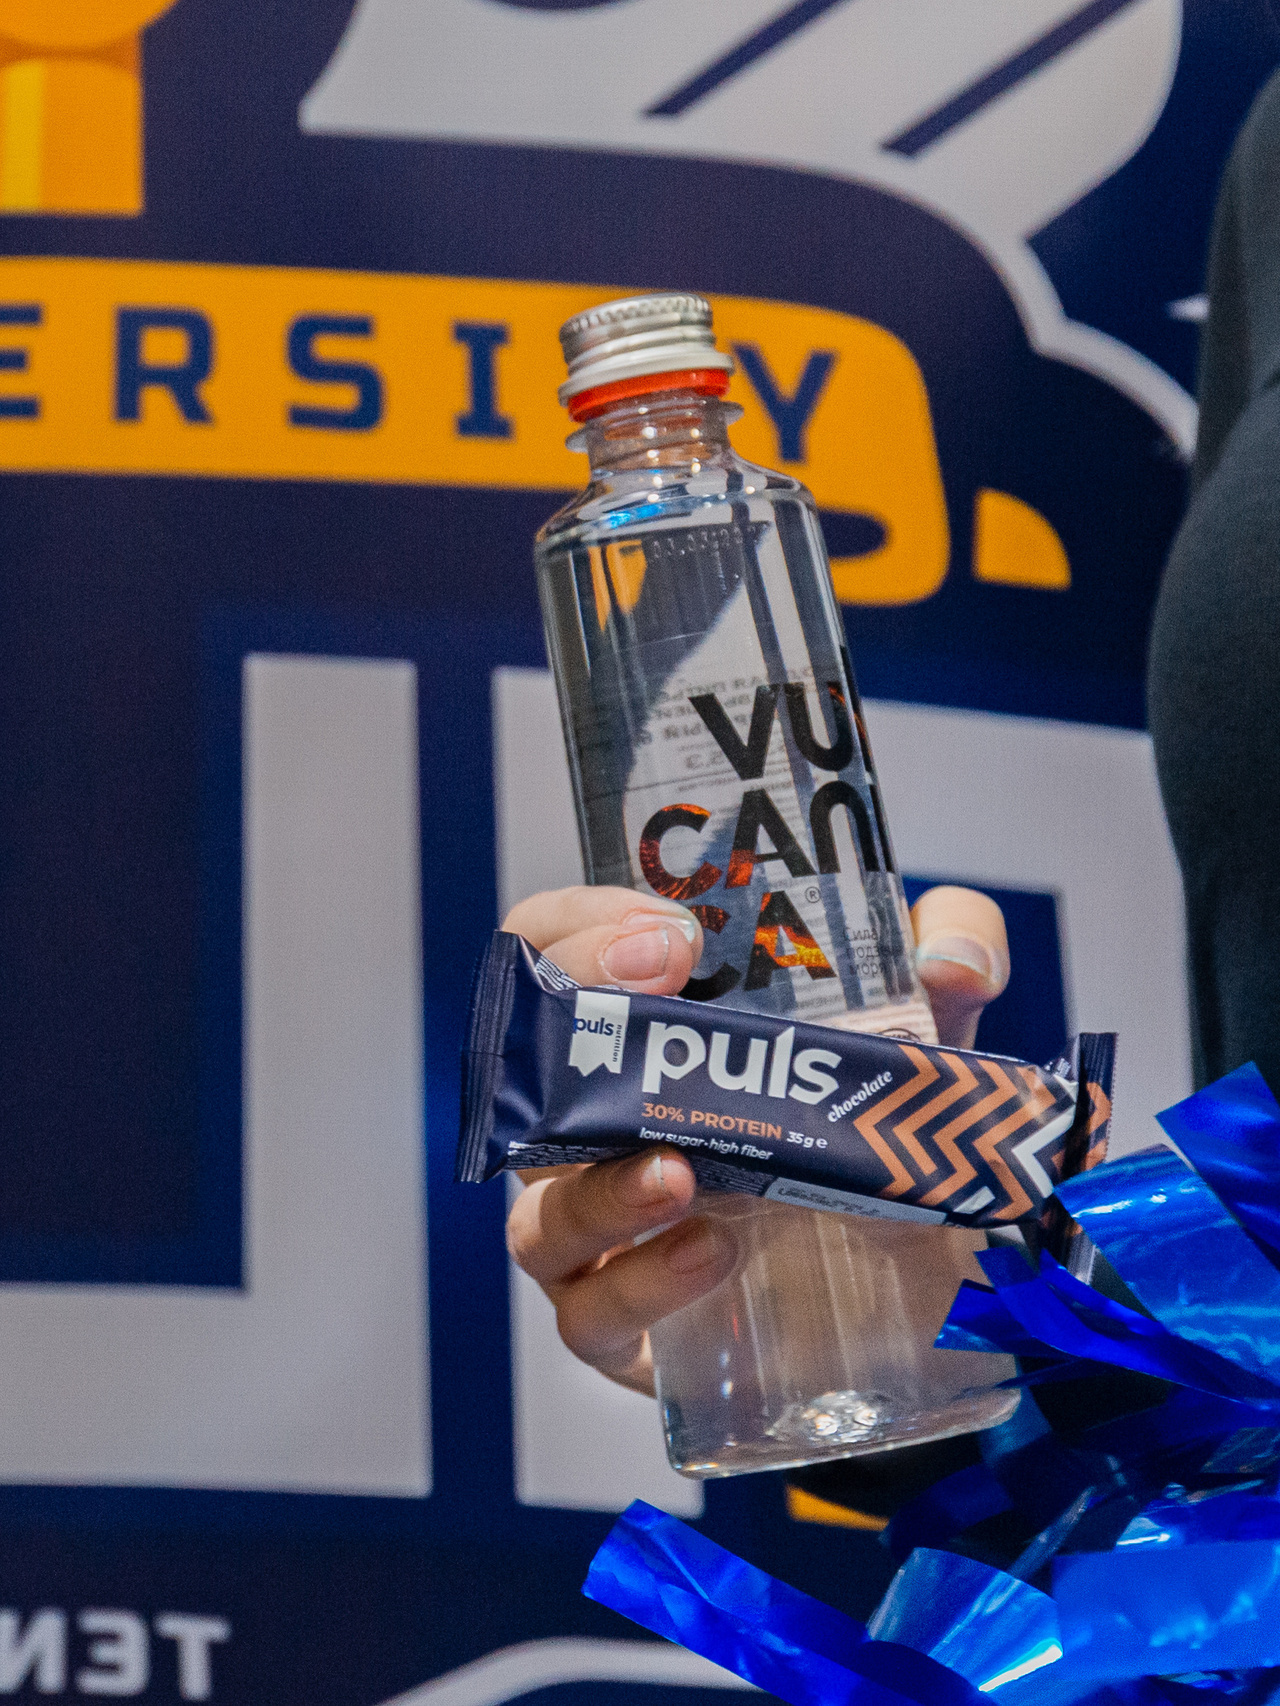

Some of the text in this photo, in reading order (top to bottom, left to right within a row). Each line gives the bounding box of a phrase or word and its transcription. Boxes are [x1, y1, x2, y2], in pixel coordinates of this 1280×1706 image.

[572, 1017, 614, 1037] puls
[612, 1024, 622, 1063] nutrition
[642, 1021, 842, 1105] puls
[827, 1070, 893, 1123] chocolate
[641, 1102, 686, 1124] 30%
[690, 1110, 782, 1140] PROTEIN
[639, 1127, 665, 1140] low
[741, 1145, 774, 1161] fiber
